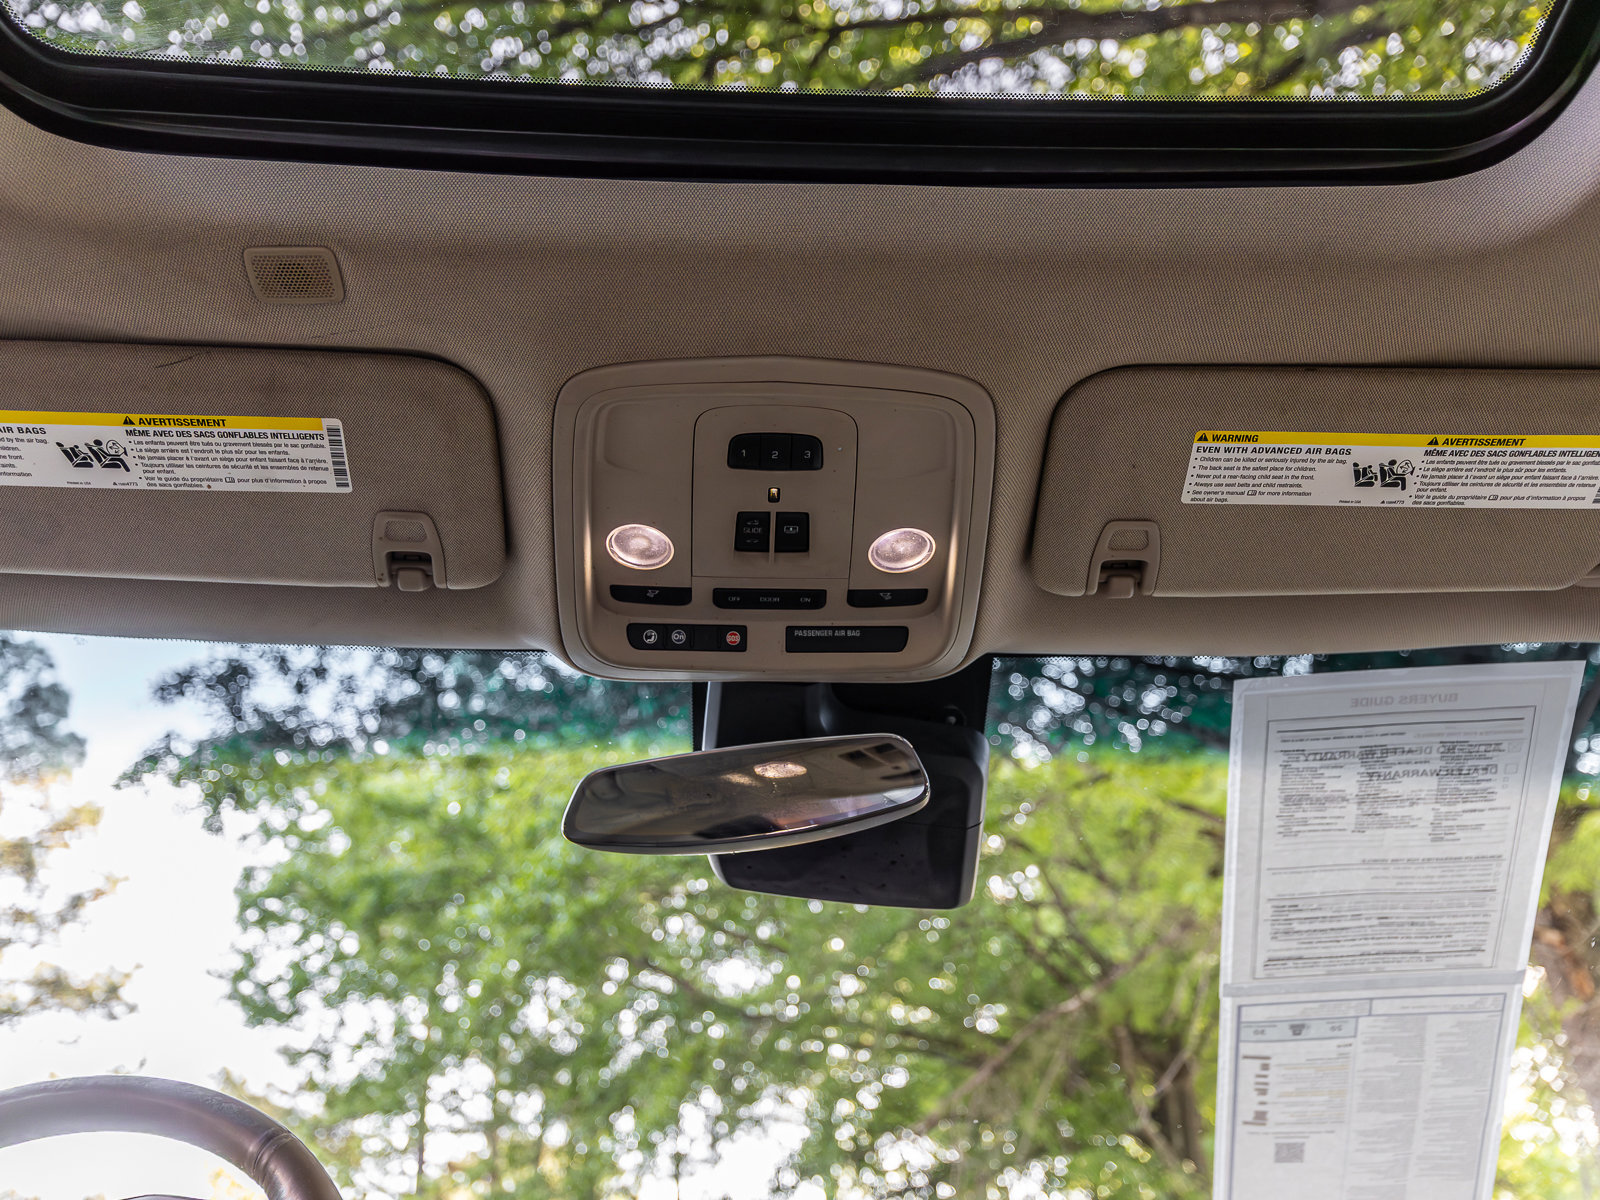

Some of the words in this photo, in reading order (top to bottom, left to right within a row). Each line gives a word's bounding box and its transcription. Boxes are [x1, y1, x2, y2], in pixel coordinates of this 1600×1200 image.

[138, 418, 226, 427] AVERTISSEMENT
[126, 428, 151, 437] MÊME
[218, 431, 269, 439] GONFLABLES
[270, 432, 325, 440] INTELLIGENTS
[1212, 434, 1259, 442] WARNING
[1442, 438, 1526, 446] AVERTISSEMENT
[1424, 448, 1448, 456] MÊME
